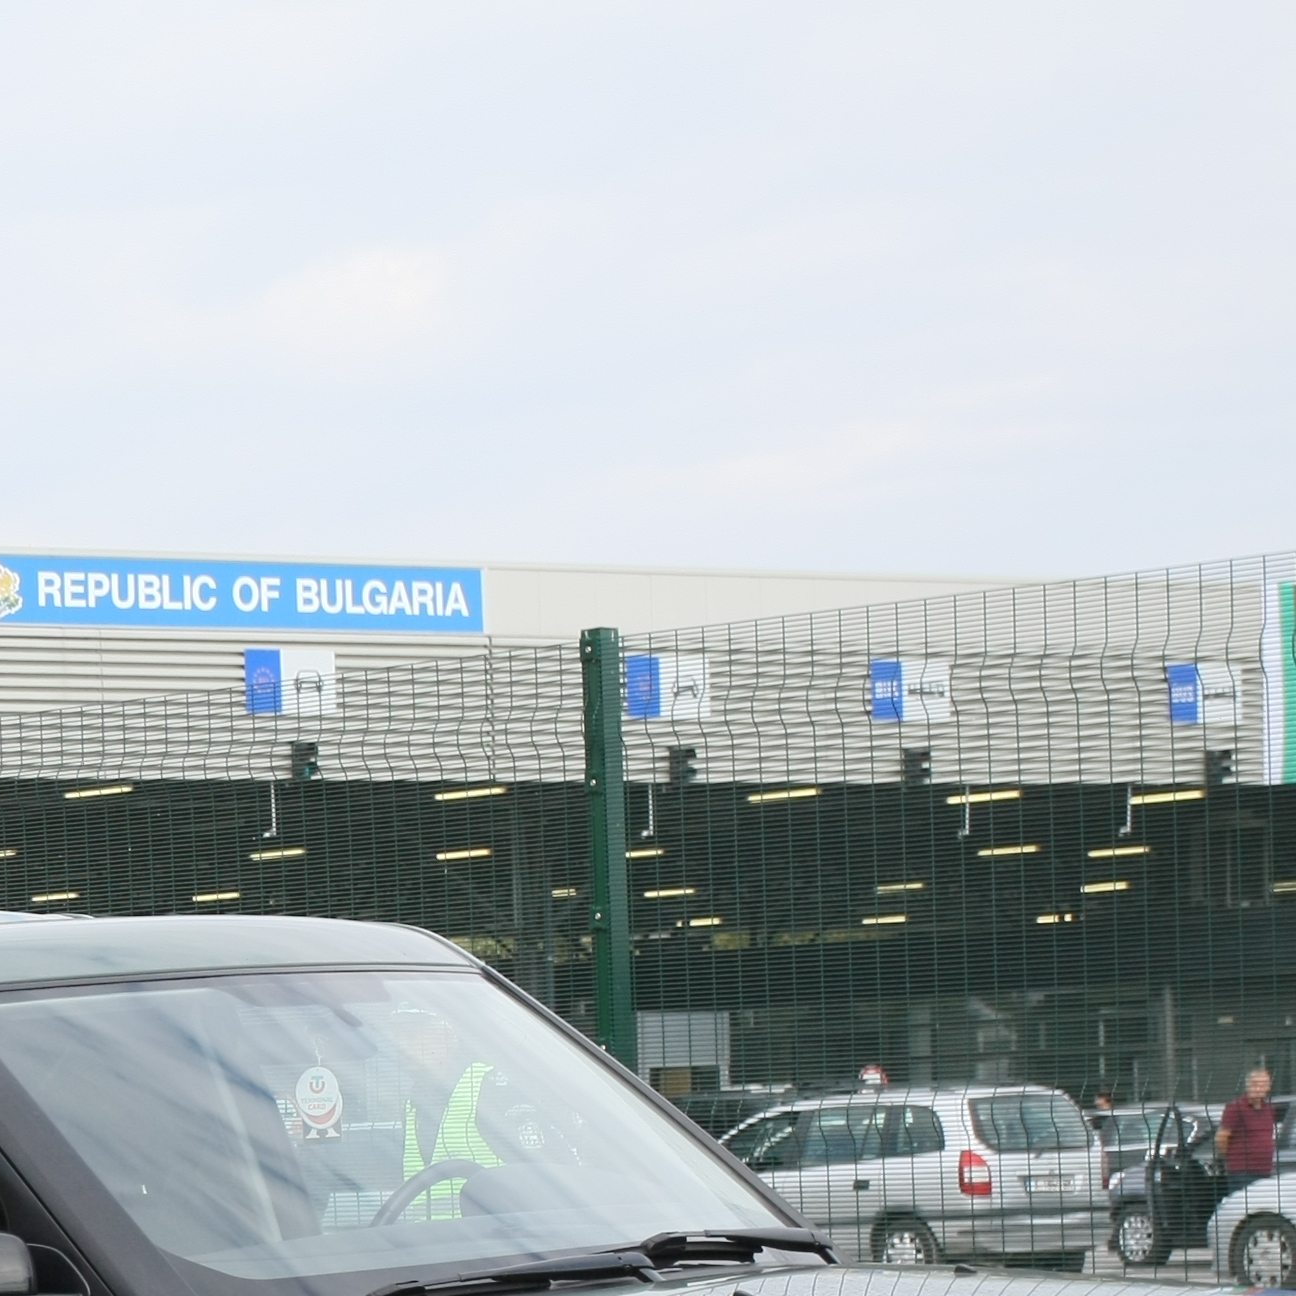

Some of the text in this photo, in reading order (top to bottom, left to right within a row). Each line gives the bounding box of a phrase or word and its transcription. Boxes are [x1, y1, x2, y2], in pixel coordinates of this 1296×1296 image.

[37, 571, 470, 617] REPUBLIC OF BULGARIA
